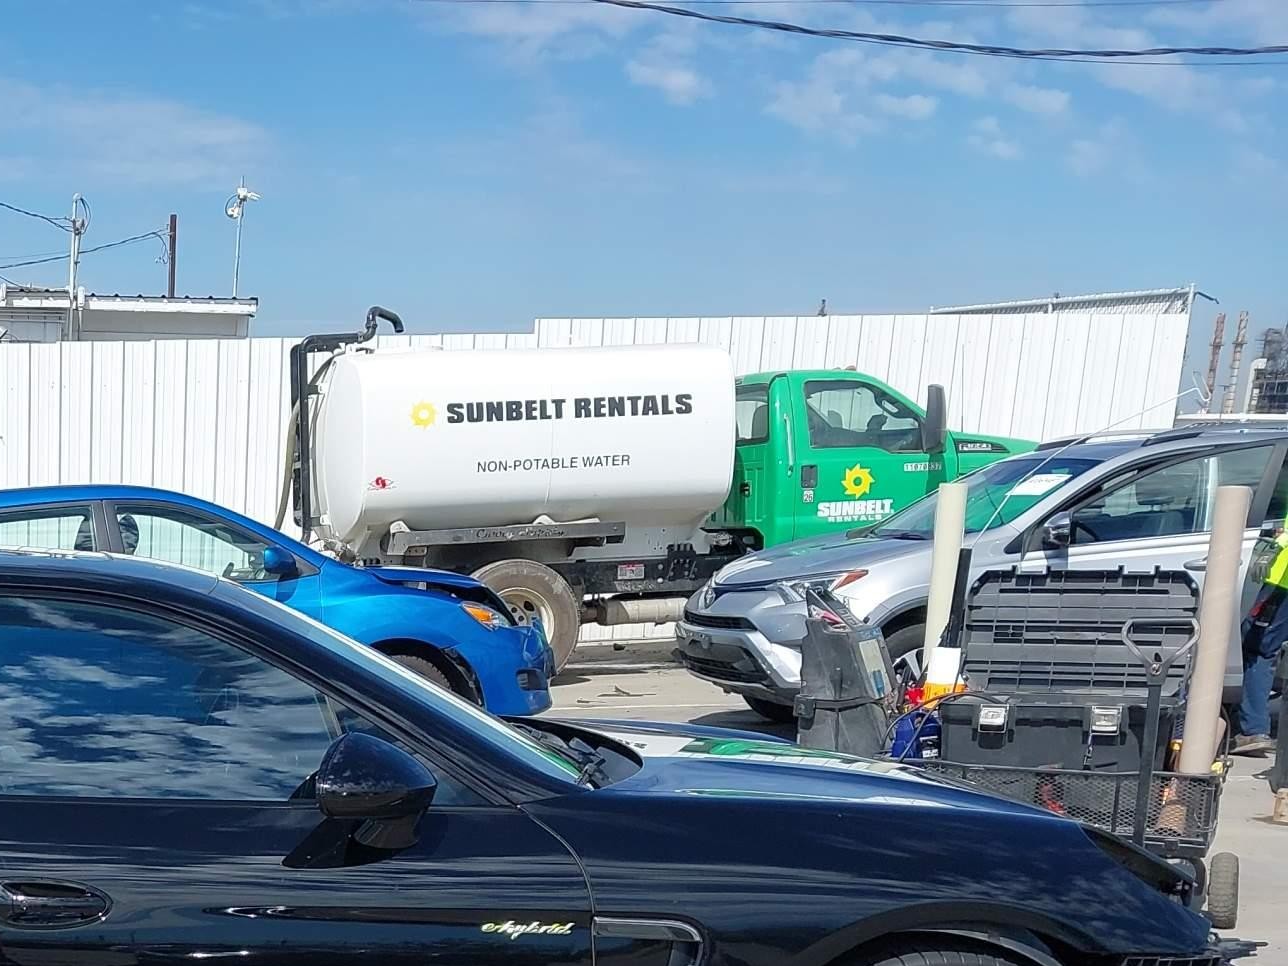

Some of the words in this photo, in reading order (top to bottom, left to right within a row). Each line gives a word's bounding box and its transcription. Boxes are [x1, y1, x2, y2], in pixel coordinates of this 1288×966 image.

[446, 398, 566, 424] SUNBELT
[574, 393, 693, 418] RENTALS
[477, 457, 578, 473] NON-POTABLE
[581, 454, 631, 469] WATER
[817, 500, 894, 516] SUNBELT
